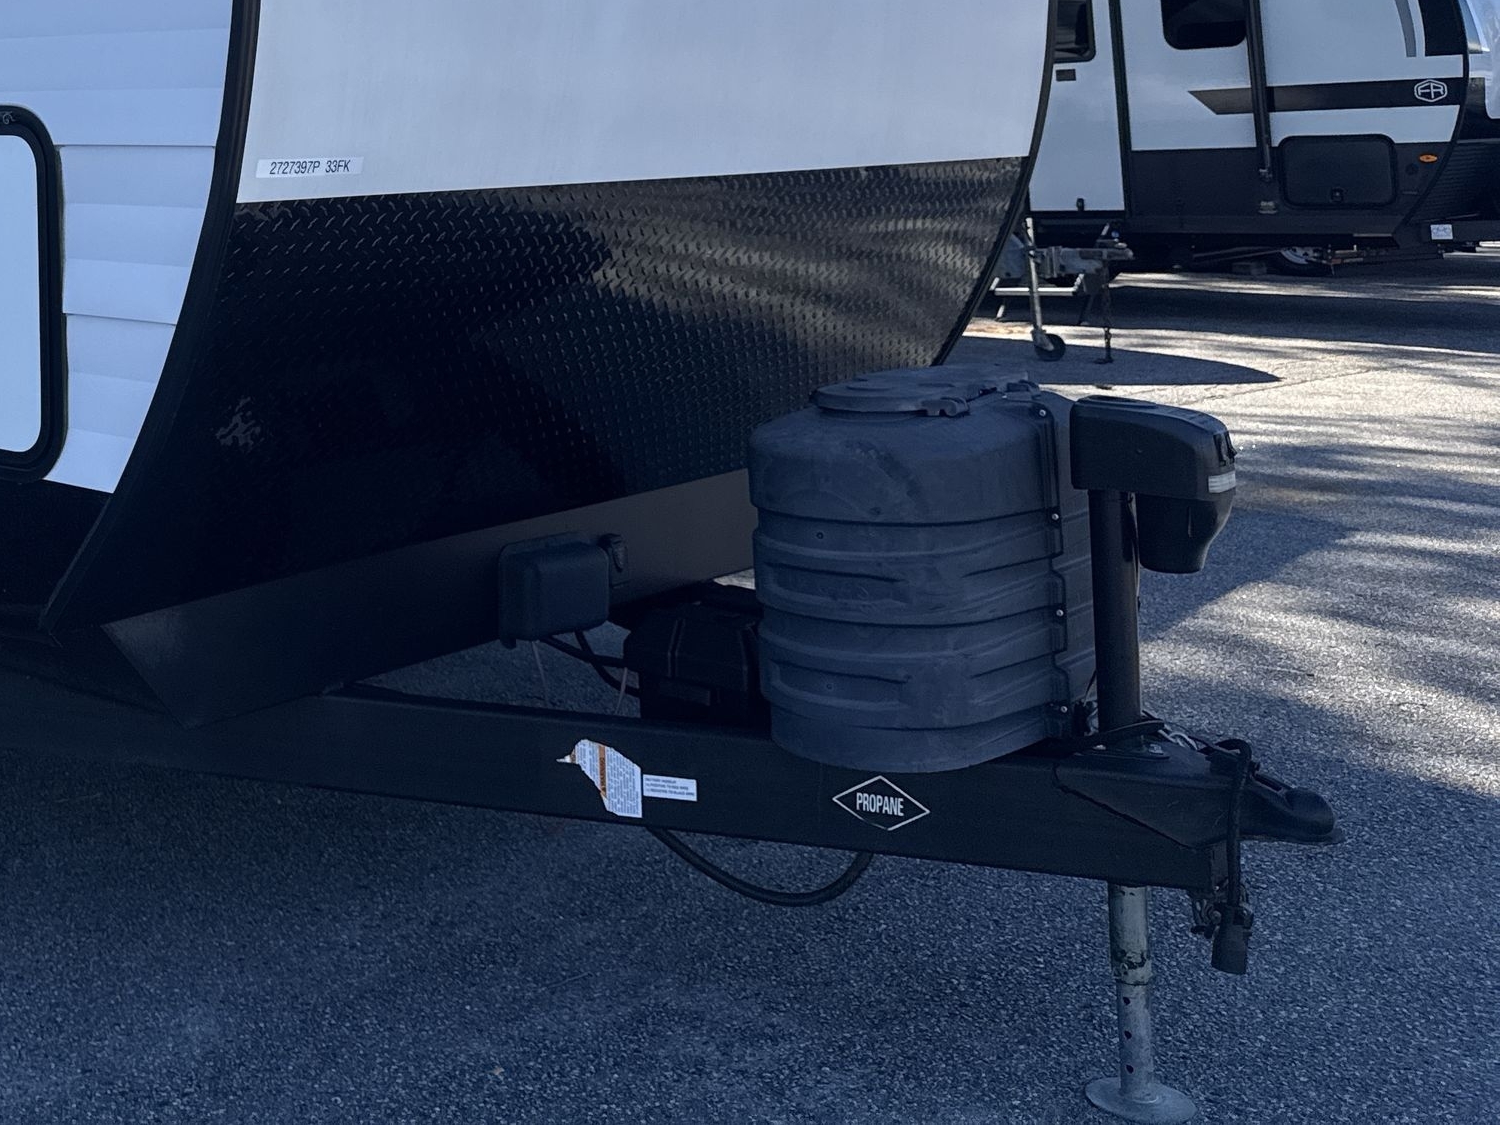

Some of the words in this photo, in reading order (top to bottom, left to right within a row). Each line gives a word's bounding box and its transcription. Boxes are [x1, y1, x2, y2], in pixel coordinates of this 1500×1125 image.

[269, 160, 320, 175] 2727397P
[325, 159, 351, 173] 33FK
[856, 792, 904, 816] PROPANE
